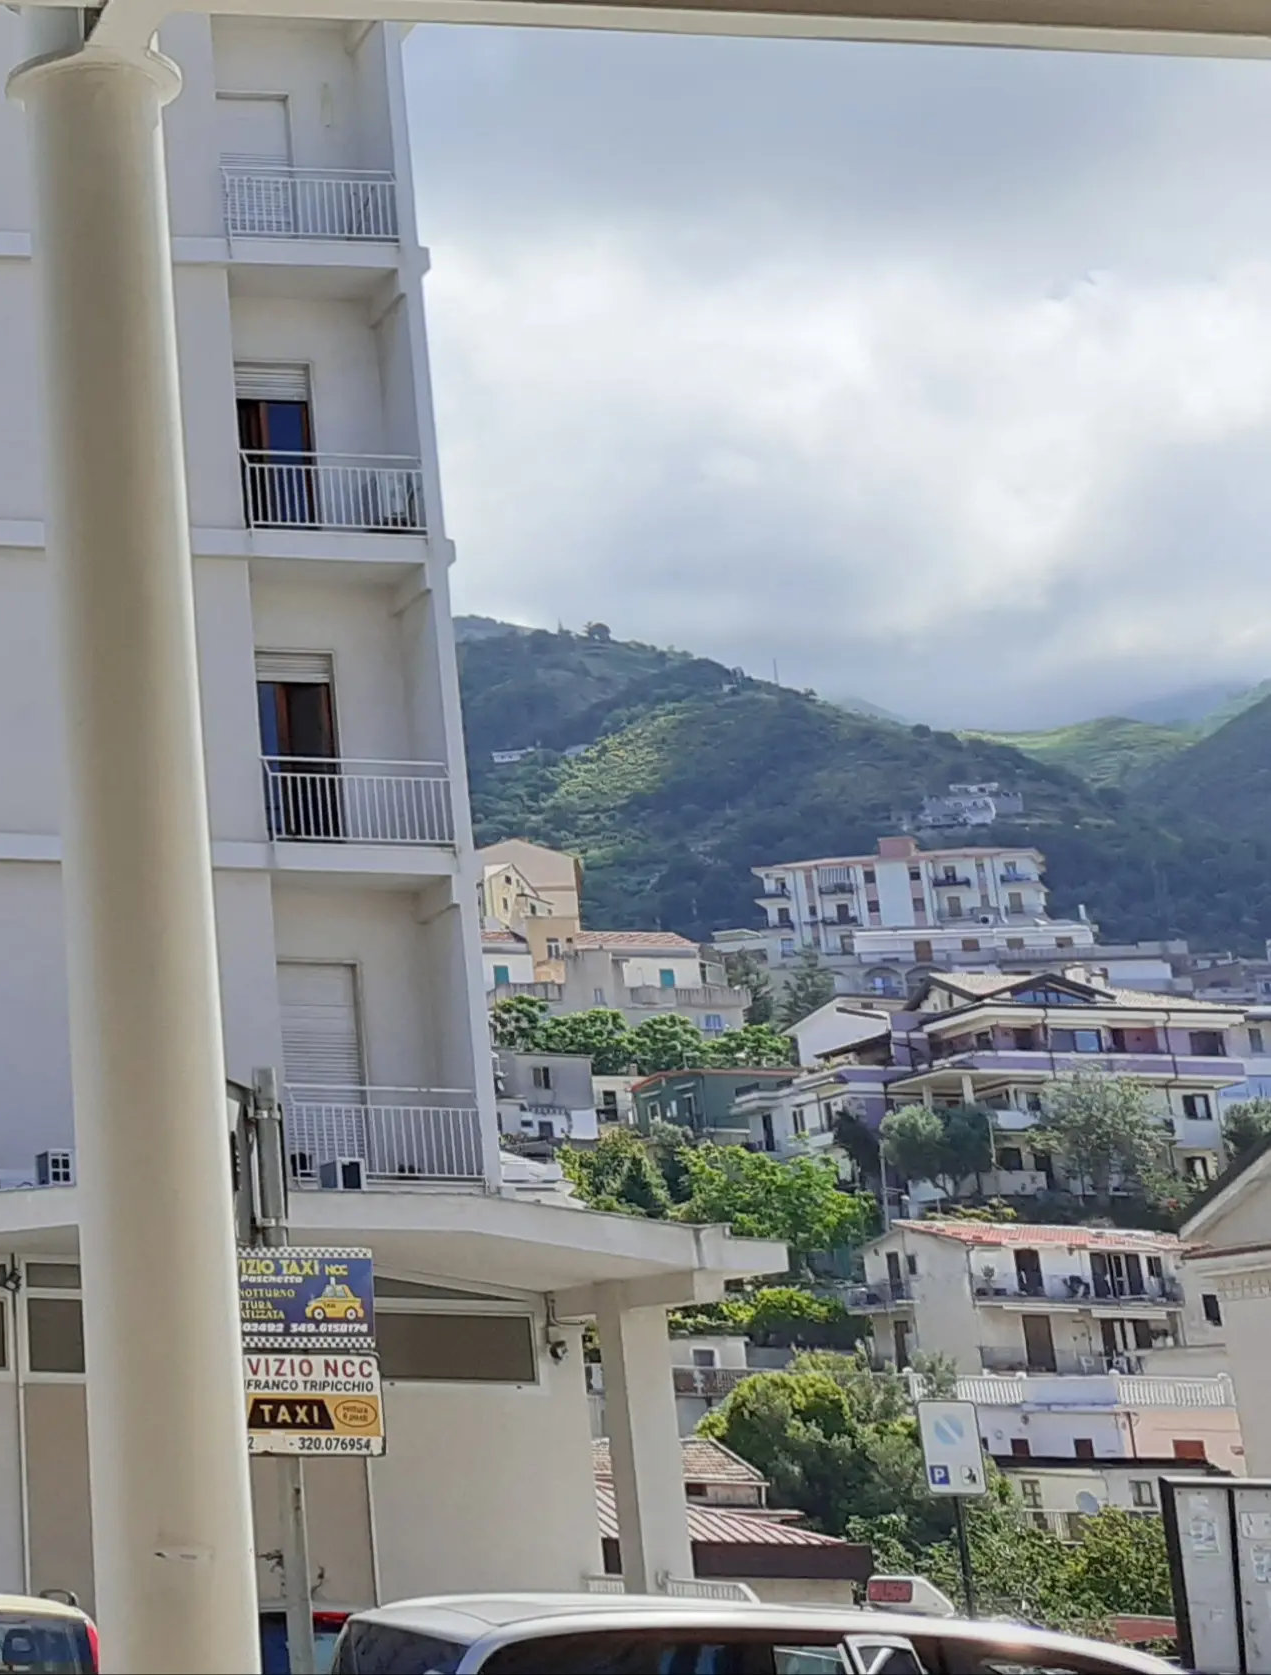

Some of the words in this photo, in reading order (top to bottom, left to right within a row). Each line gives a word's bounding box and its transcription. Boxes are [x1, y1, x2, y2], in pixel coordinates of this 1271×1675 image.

[238, 1258, 275, 1275] IZIO
[280, 1259, 319, 1276] TAXI
[324, 1264, 348, 1276] NCC
[247, 1357, 313, 1378] VIZIO
[323, 1358, 374, 1379] NCC
[244, 1379, 299, 1392] FRANCO
[302, 1380, 375, 1393] TRIPICCHIO
[259, 1404, 321, 1424] TAXI
[932, 1467, 945, 1484] P
